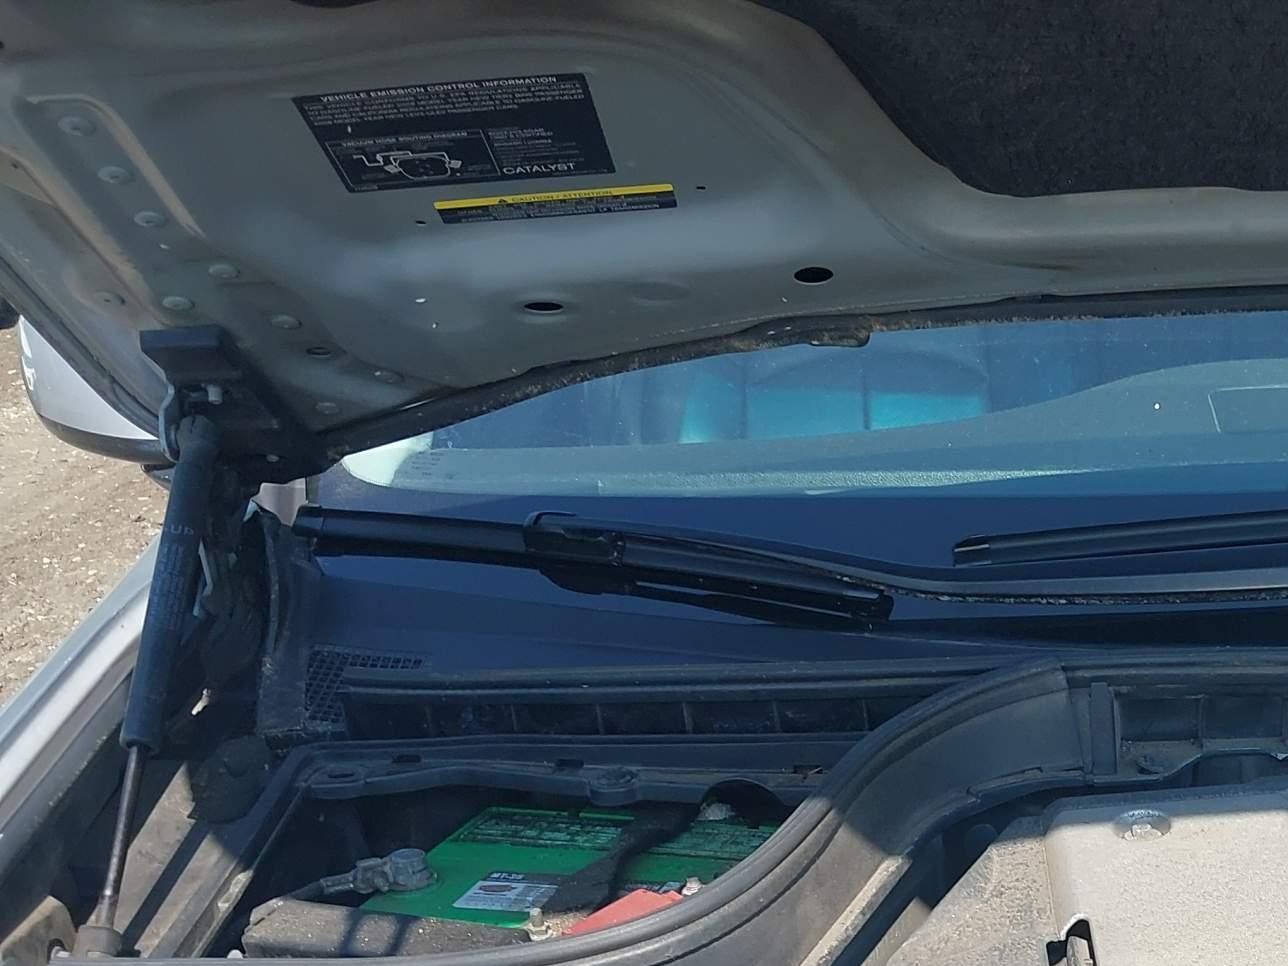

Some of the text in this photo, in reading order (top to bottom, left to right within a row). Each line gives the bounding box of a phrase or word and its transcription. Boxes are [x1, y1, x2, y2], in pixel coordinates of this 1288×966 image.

[320, 76, 557, 102] VEHICLE EMISSION CONTROL INFORMATION
[503, 163, 576, 175] CATALYST
